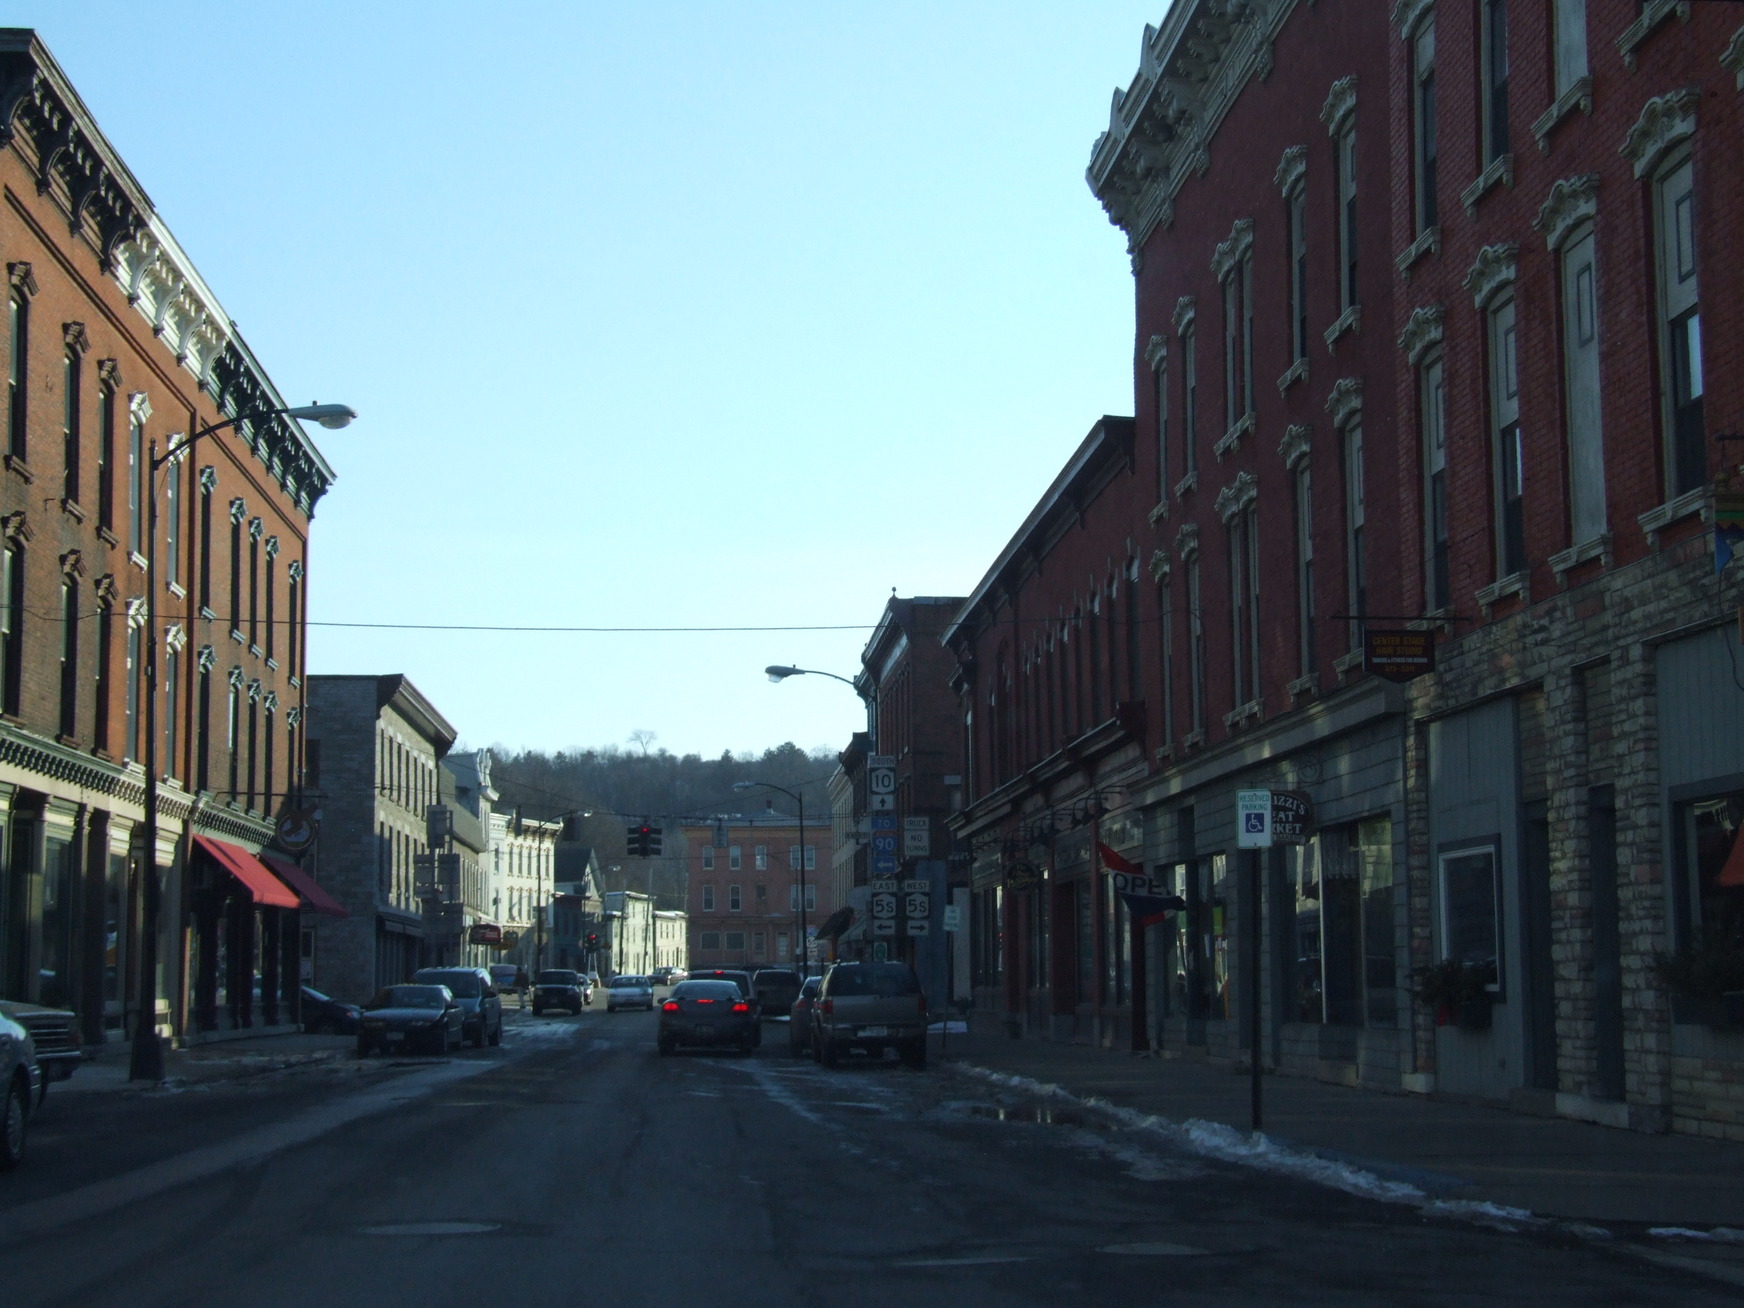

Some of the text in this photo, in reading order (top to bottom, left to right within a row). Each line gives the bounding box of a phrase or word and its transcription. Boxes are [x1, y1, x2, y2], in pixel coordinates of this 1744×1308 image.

[870, 756, 895, 767] SOUTH
[874, 774, 891, 788] 10
[1239, 794, 1270, 803] RESERVED
[1241, 803, 1268, 811] PARKING
[1272, 795, 1306, 815] IZZI'S
[878, 820, 890, 828] TO
[906, 818, 928, 828] TRUCK
[911, 834, 923, 843] NO
[875, 838, 894, 851] 90
[905, 844, 928, 853] TURNS
[873, 882, 896, 891] EAST
[906, 882, 928, 891] WEST
[1113, 873, 1171, 895] OPE
[875, 900, 894, 914] 5S
[908, 900, 927, 914] 5S
